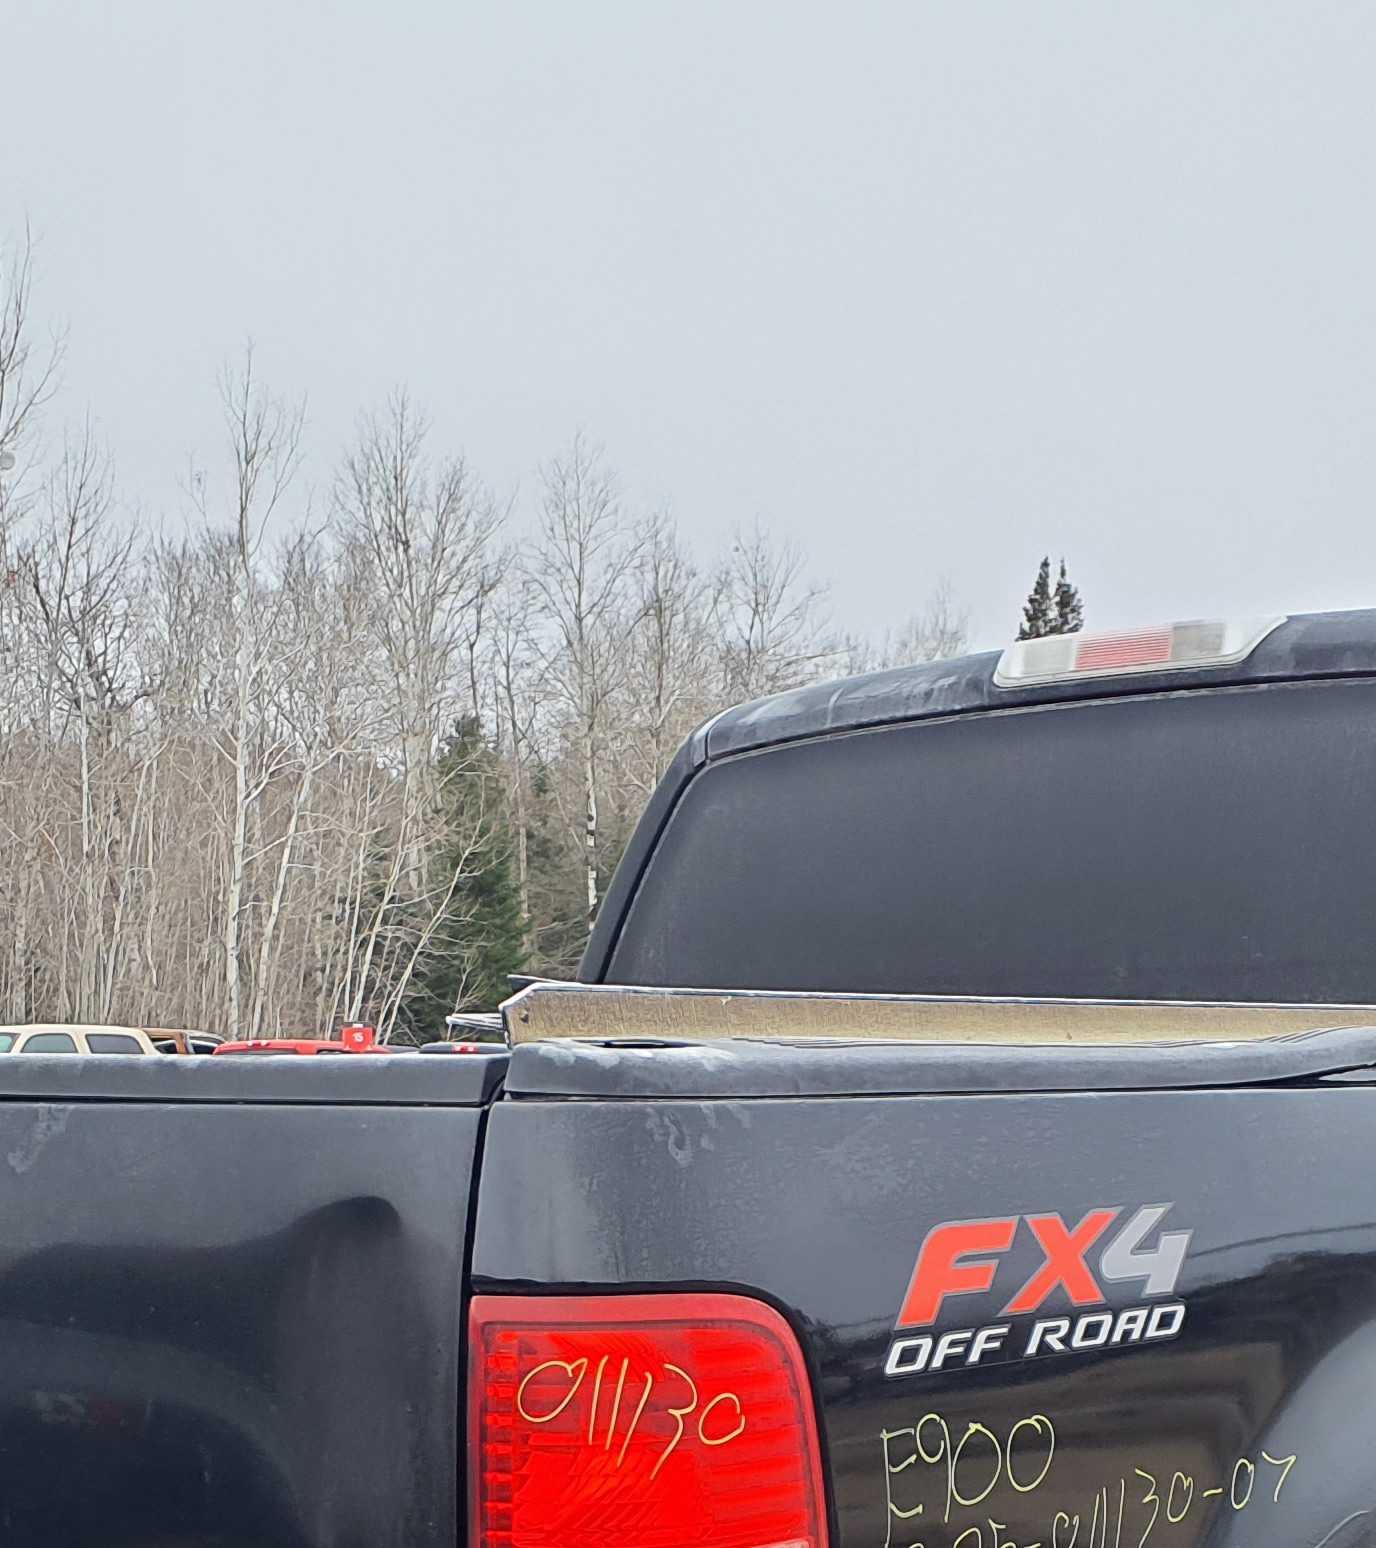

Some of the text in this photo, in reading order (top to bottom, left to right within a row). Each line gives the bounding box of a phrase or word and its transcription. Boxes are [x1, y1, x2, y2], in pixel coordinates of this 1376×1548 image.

[894, 1201, 1194, 1331] FX4
[883, 1302, 1187, 1378] OFF ROAD
[517, 1355, 746, 1480] 011130
[880, 1413, 1056, 1548] E900
